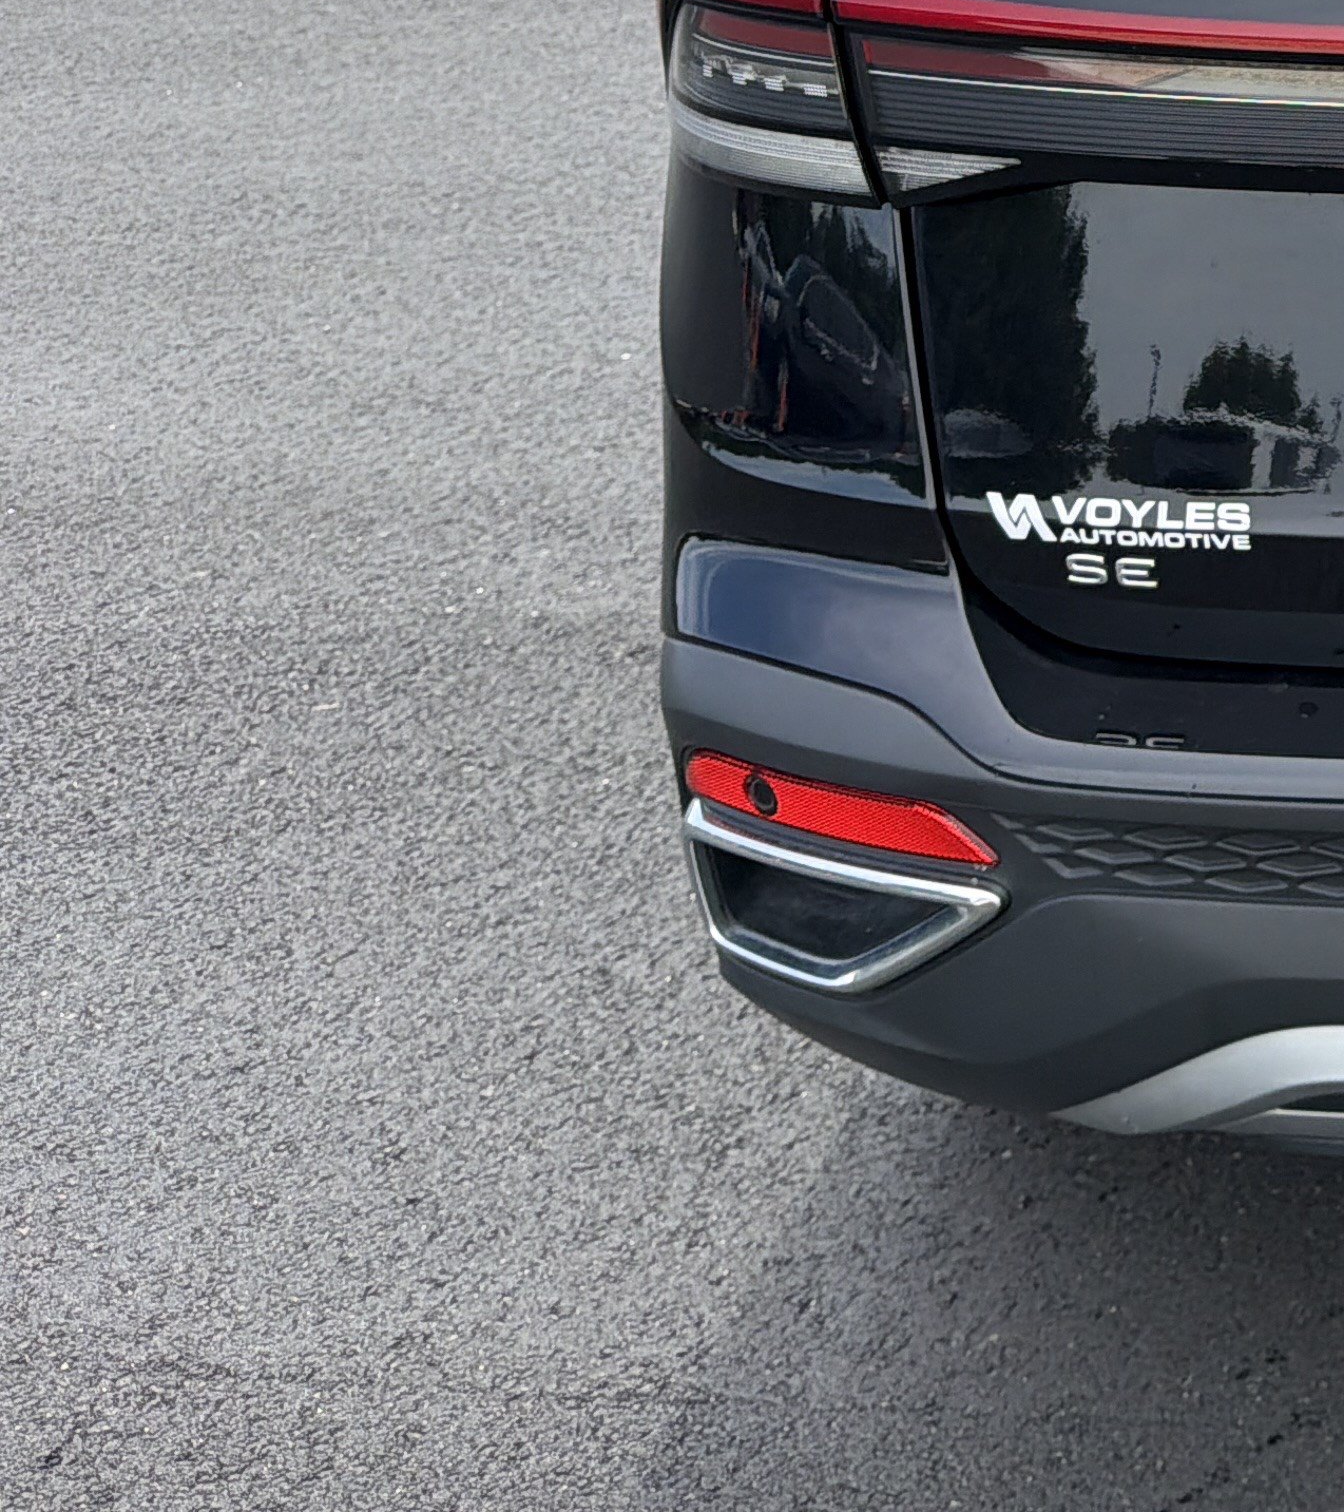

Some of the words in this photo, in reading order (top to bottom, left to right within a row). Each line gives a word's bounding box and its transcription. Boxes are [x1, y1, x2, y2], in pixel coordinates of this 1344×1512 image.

[1051, 495, 1252, 532] VOYLES
[1060, 526, 1252, 551] AUTOMOTIVE
[1066, 553, 1159, 589] SE
